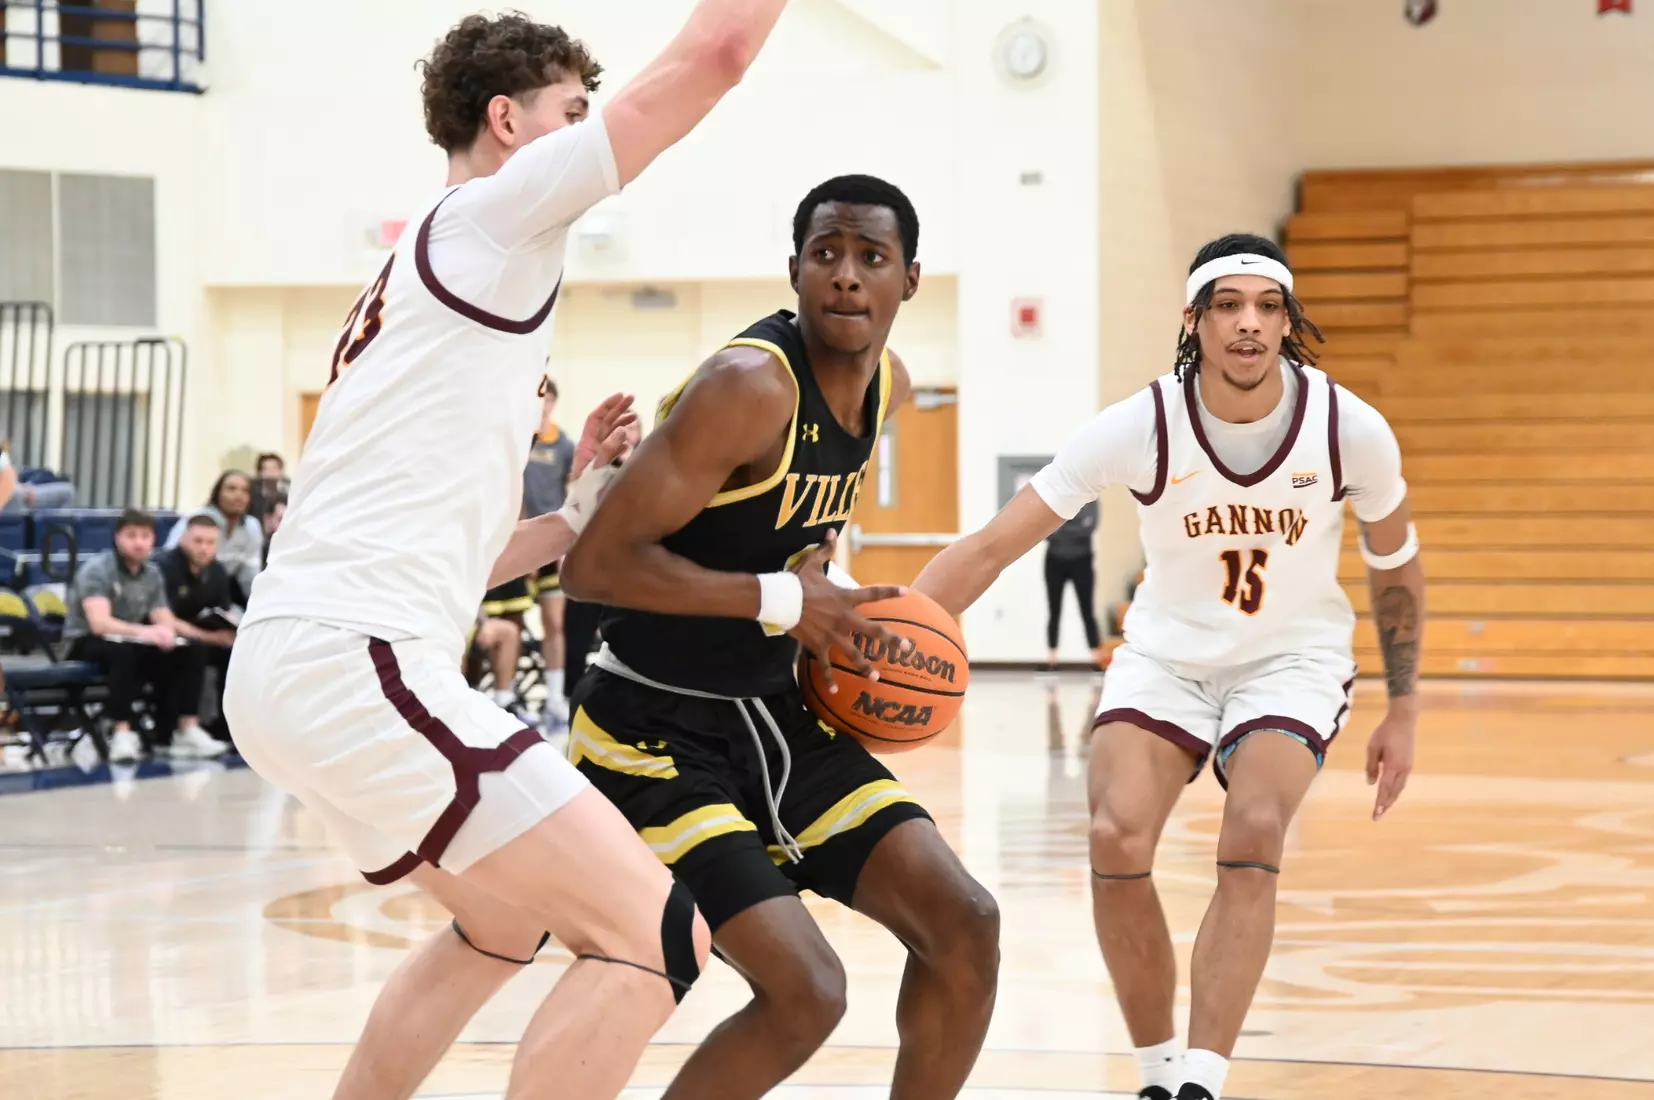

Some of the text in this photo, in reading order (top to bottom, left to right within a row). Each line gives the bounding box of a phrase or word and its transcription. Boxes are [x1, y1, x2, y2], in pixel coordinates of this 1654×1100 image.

[1291, 475, 1318, 484] PSAC
[1183, 504, 1308, 546] GANNON
[1219, 548, 1270, 616] 15
[852, 631, 956, 684] Wilson
[851, 691, 934, 726] NCAA
